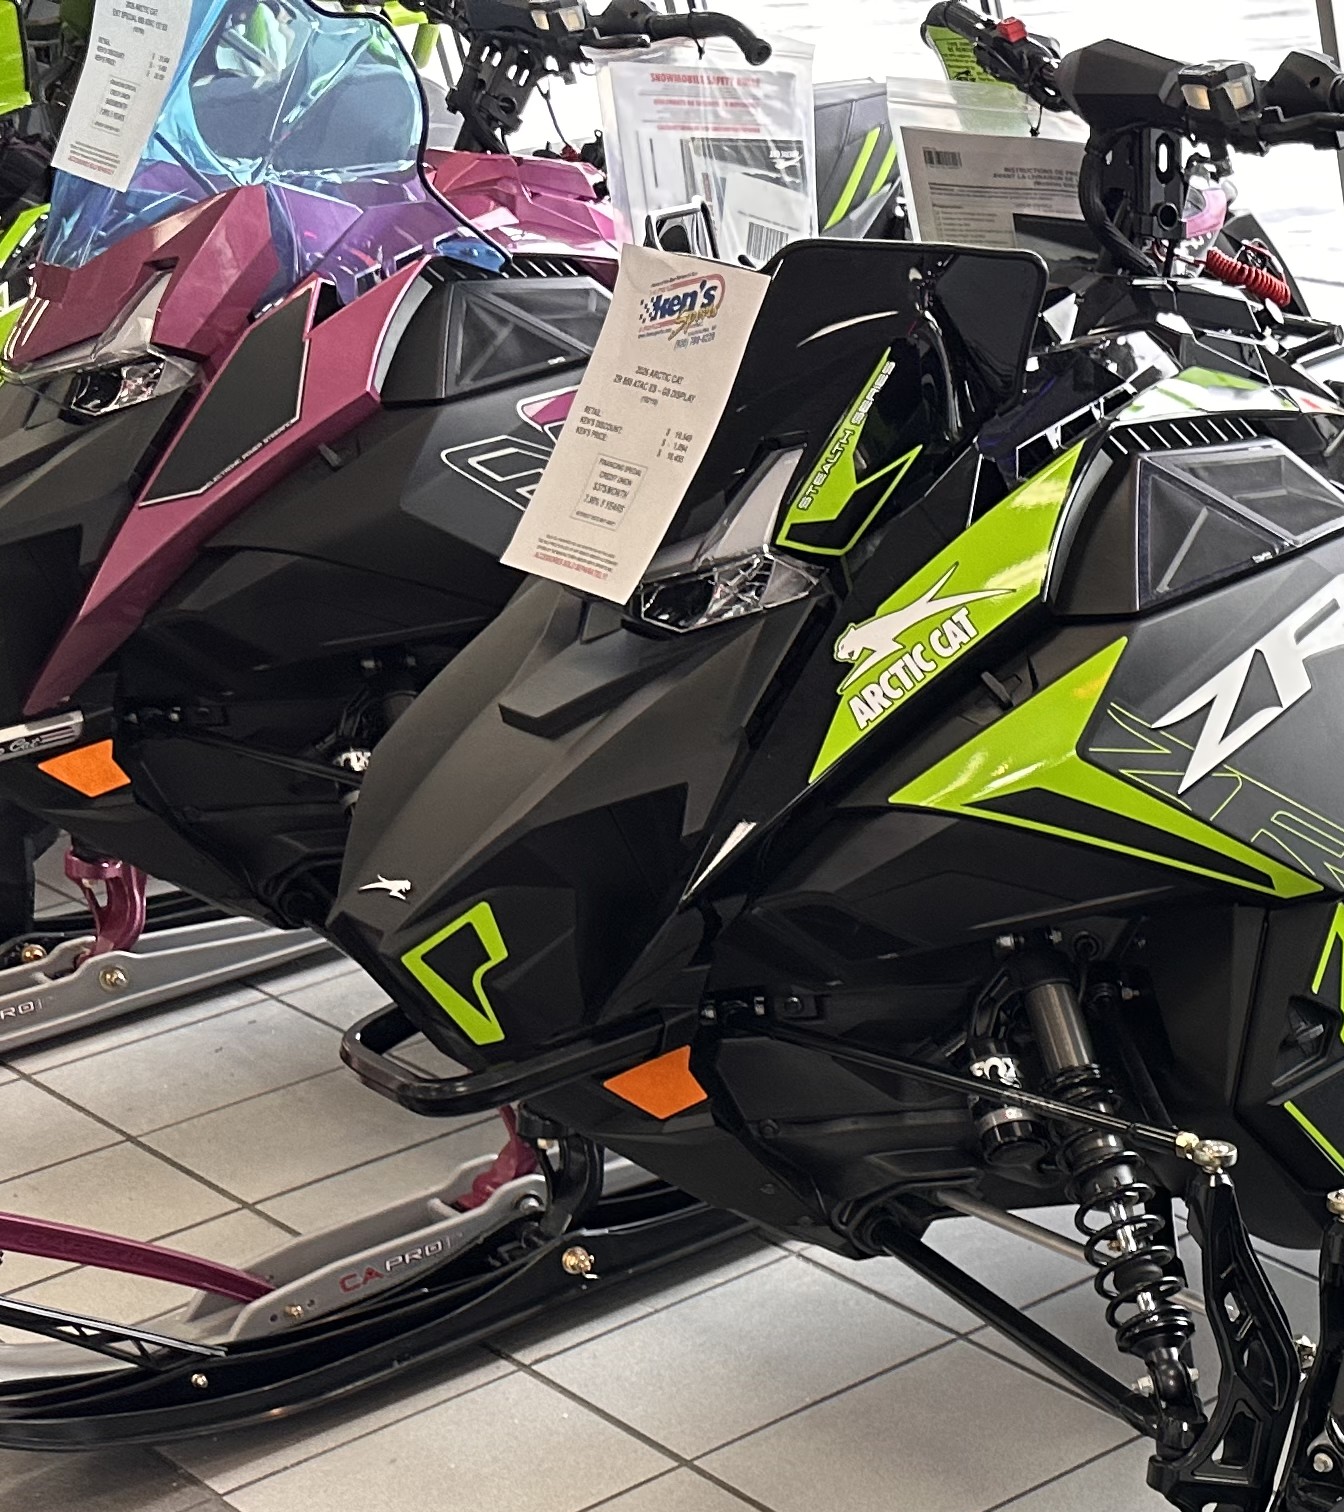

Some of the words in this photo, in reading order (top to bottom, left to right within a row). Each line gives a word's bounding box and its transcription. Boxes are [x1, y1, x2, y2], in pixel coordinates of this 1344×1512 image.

[798, 428, 855, 510] STEALTH
[850, 360, 896, 426] SERIES
[848, 642, 938, 731] ARCTIC
[928, 605, 979, 658] CAT
